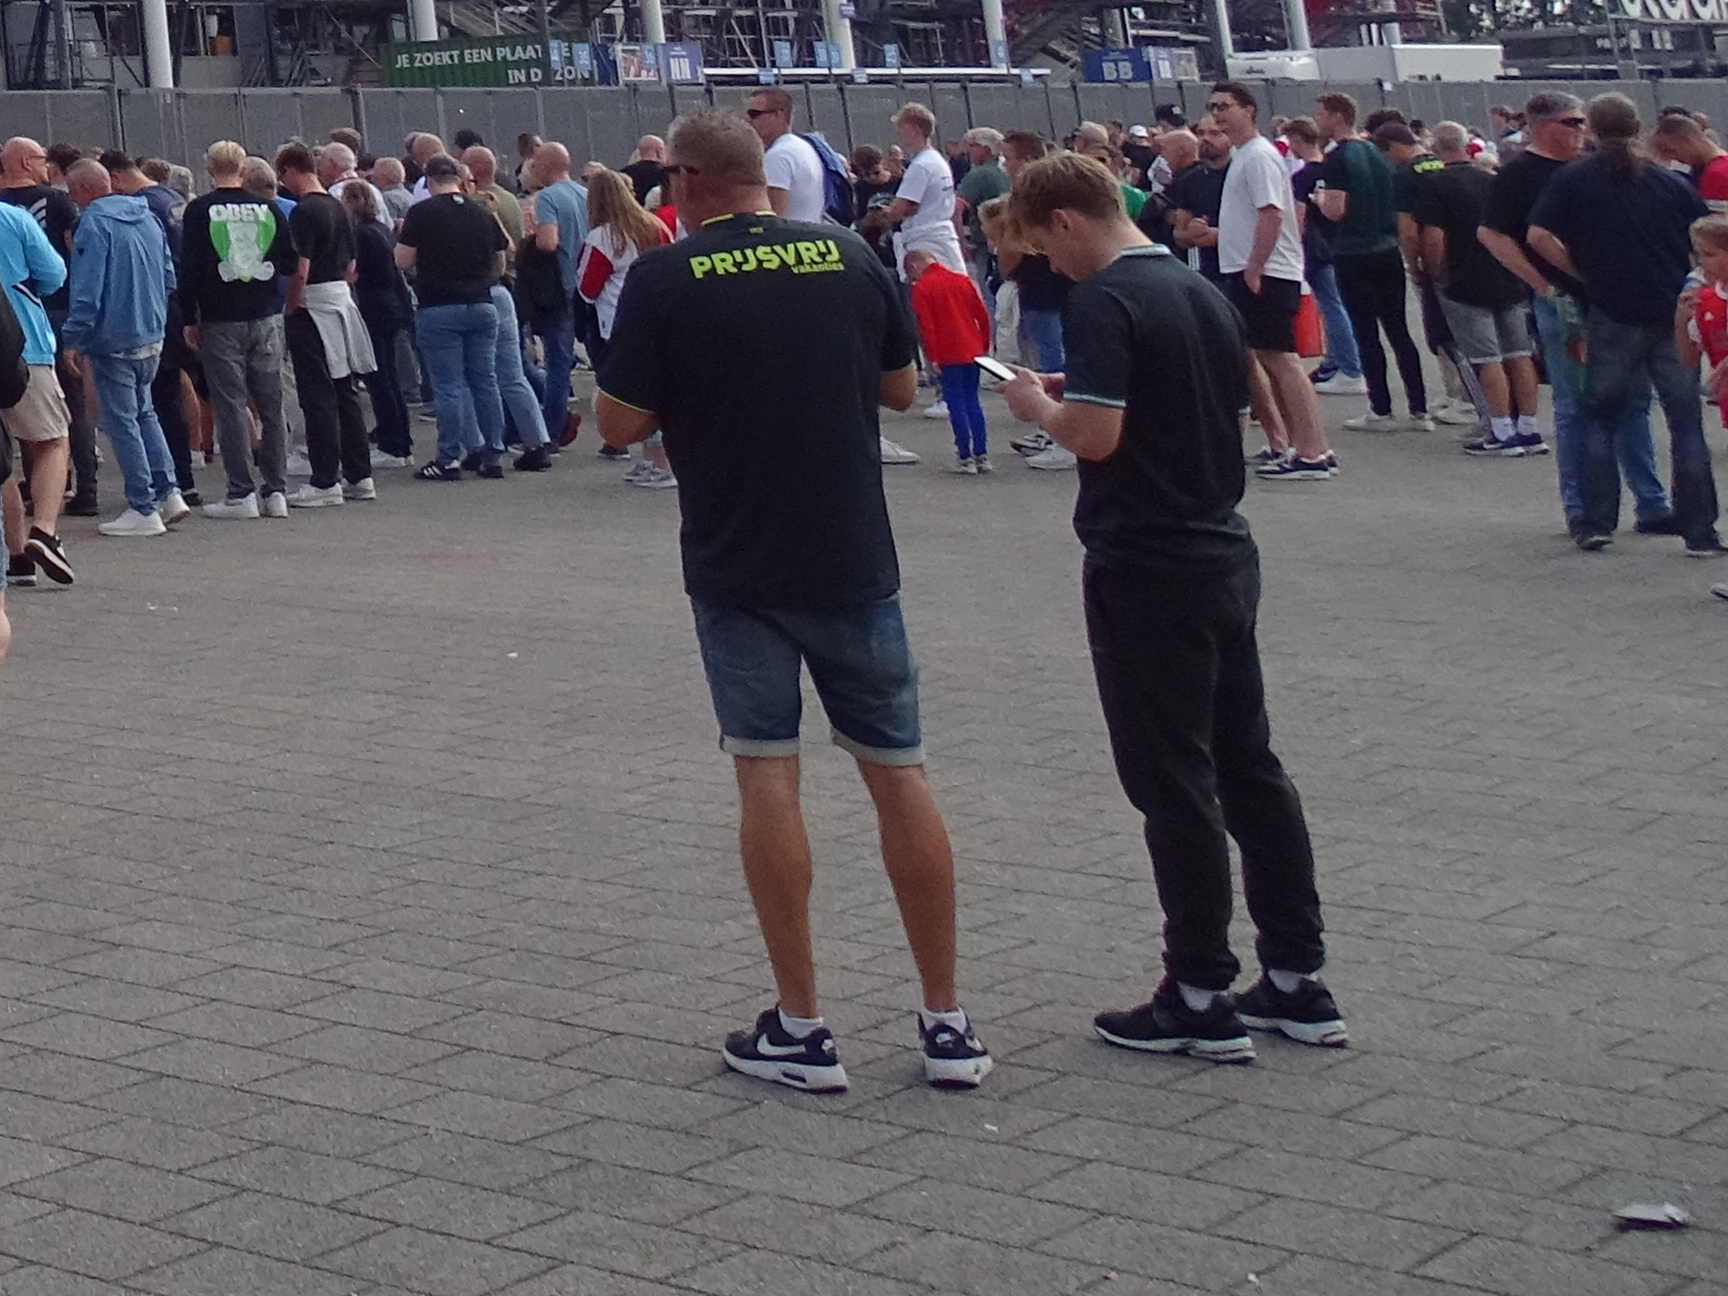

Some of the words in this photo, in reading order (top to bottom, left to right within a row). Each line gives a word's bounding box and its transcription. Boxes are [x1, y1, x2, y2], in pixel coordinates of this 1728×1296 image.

[395, 54, 411, 69] JE
[413, 51, 460, 67] ZOEKT
[464, 47, 493, 64] EEN
[507, 68, 526, 84] IN
[530, 68, 543, 83] D
